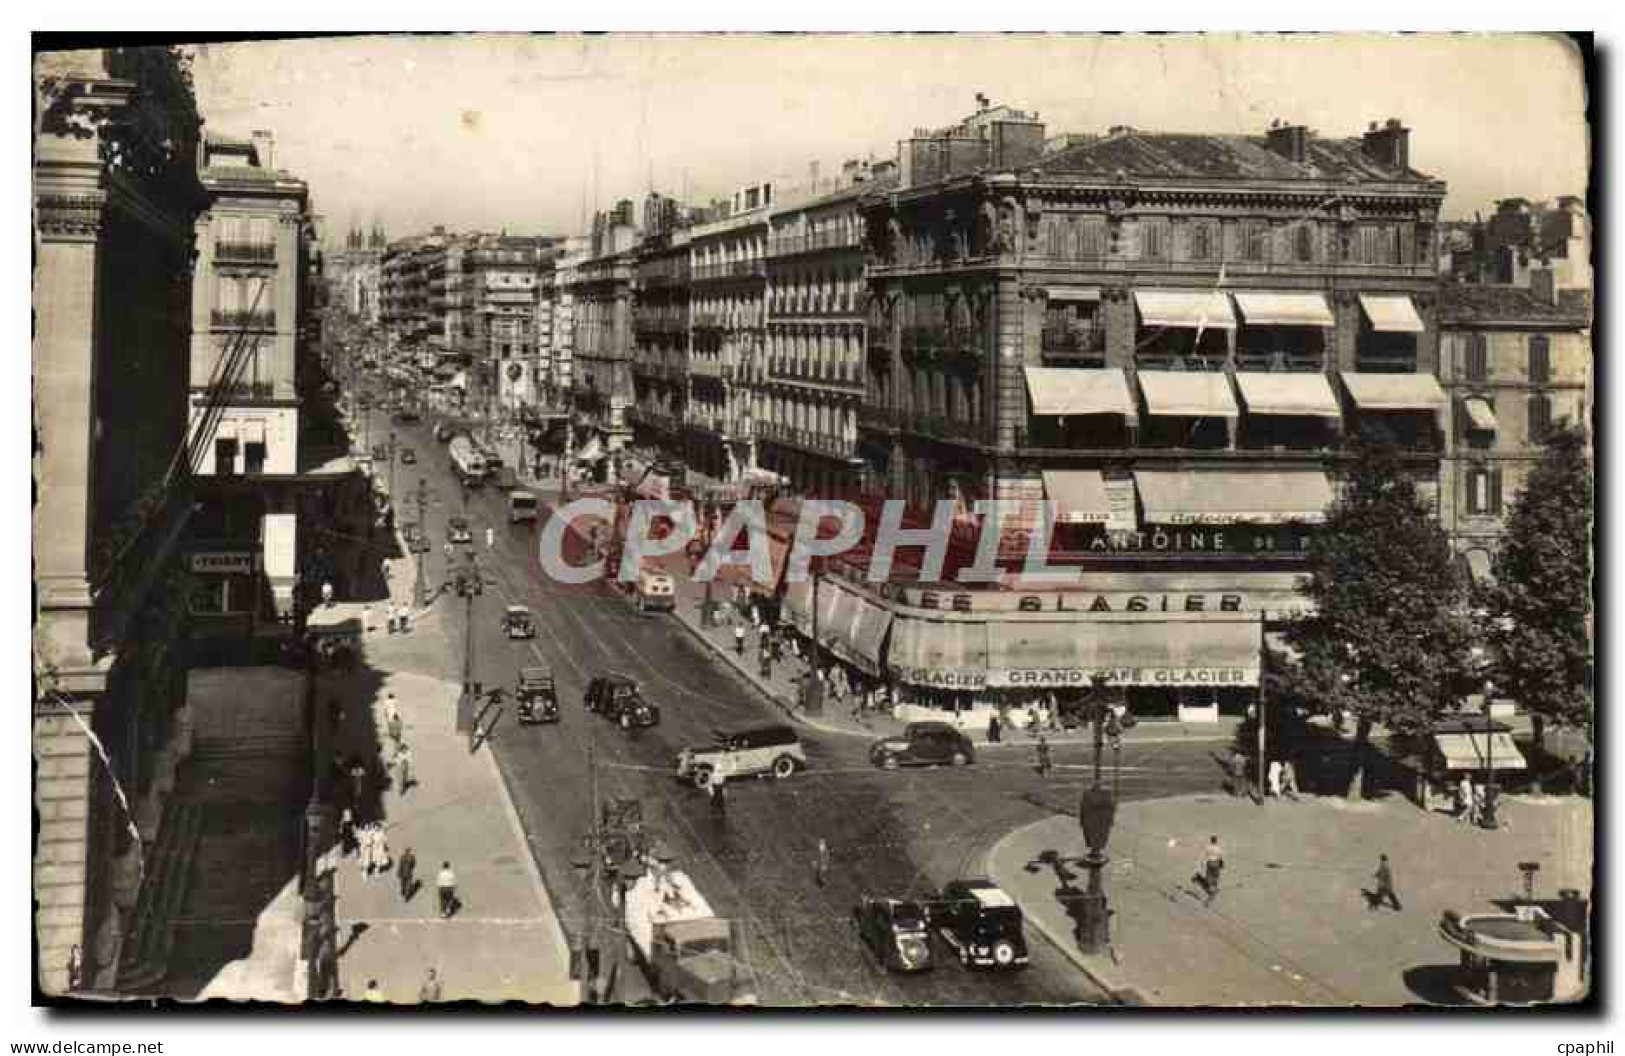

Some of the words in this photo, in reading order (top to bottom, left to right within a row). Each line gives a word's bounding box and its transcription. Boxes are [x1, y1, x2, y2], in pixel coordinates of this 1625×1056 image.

[1090, 533, 1222, 549] ANTOINE
[1017, 593, 1242, 612] GLACIER
[912, 668, 985, 687] GLACIER
[1008, 671, 1082, 683] GRAND
[1155, 671, 1244, 682] GLACIER
